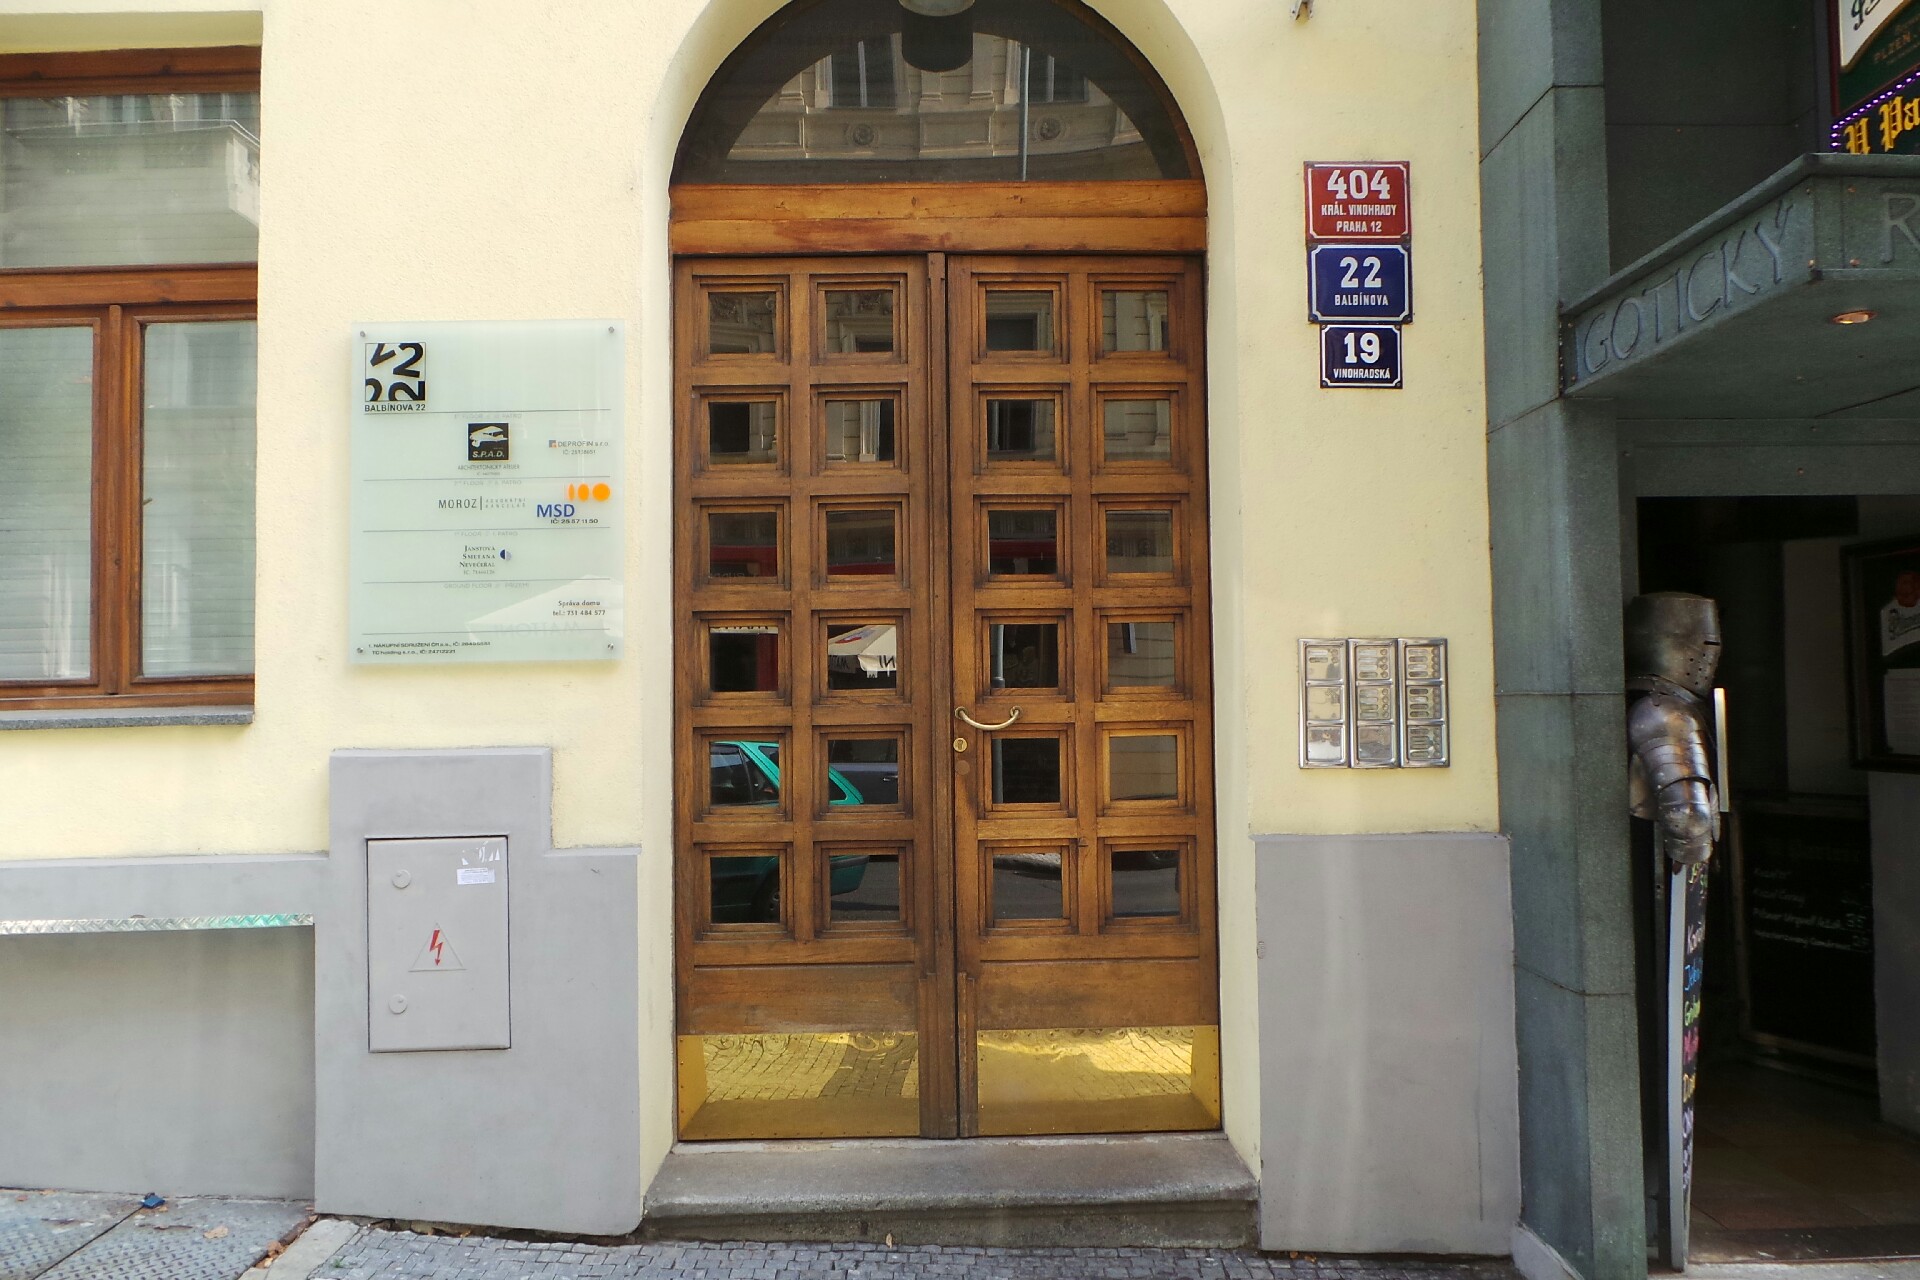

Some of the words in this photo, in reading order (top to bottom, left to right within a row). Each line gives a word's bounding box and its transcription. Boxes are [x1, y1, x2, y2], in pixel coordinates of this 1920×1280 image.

[1327, 170, 1390, 199] 404
[1321, 201, 1347, 216] KRÁL.
[1348, 204, 1397, 216] VINOHRADY
[1336, 221, 1367, 232] PRAHA
[1370, 220, 1382, 232] 12
[1340, 257, 1382, 288] 22
[1335, 292, 1388, 306] BALBÍNOVA
[1344, 332, 1380, 364] 19
[1333, 367, 1391, 379] VINOHRADSKÁ
[365, 403, 413, 412] BALBÍNOVA
[415, 403, 426, 411] 22
[472, 450, 505, 459] S.P.A.D.
[438, 498, 477, 509] MOROZ
[536, 504, 576, 518] MSD
[558, 600, 580, 608] Správa
